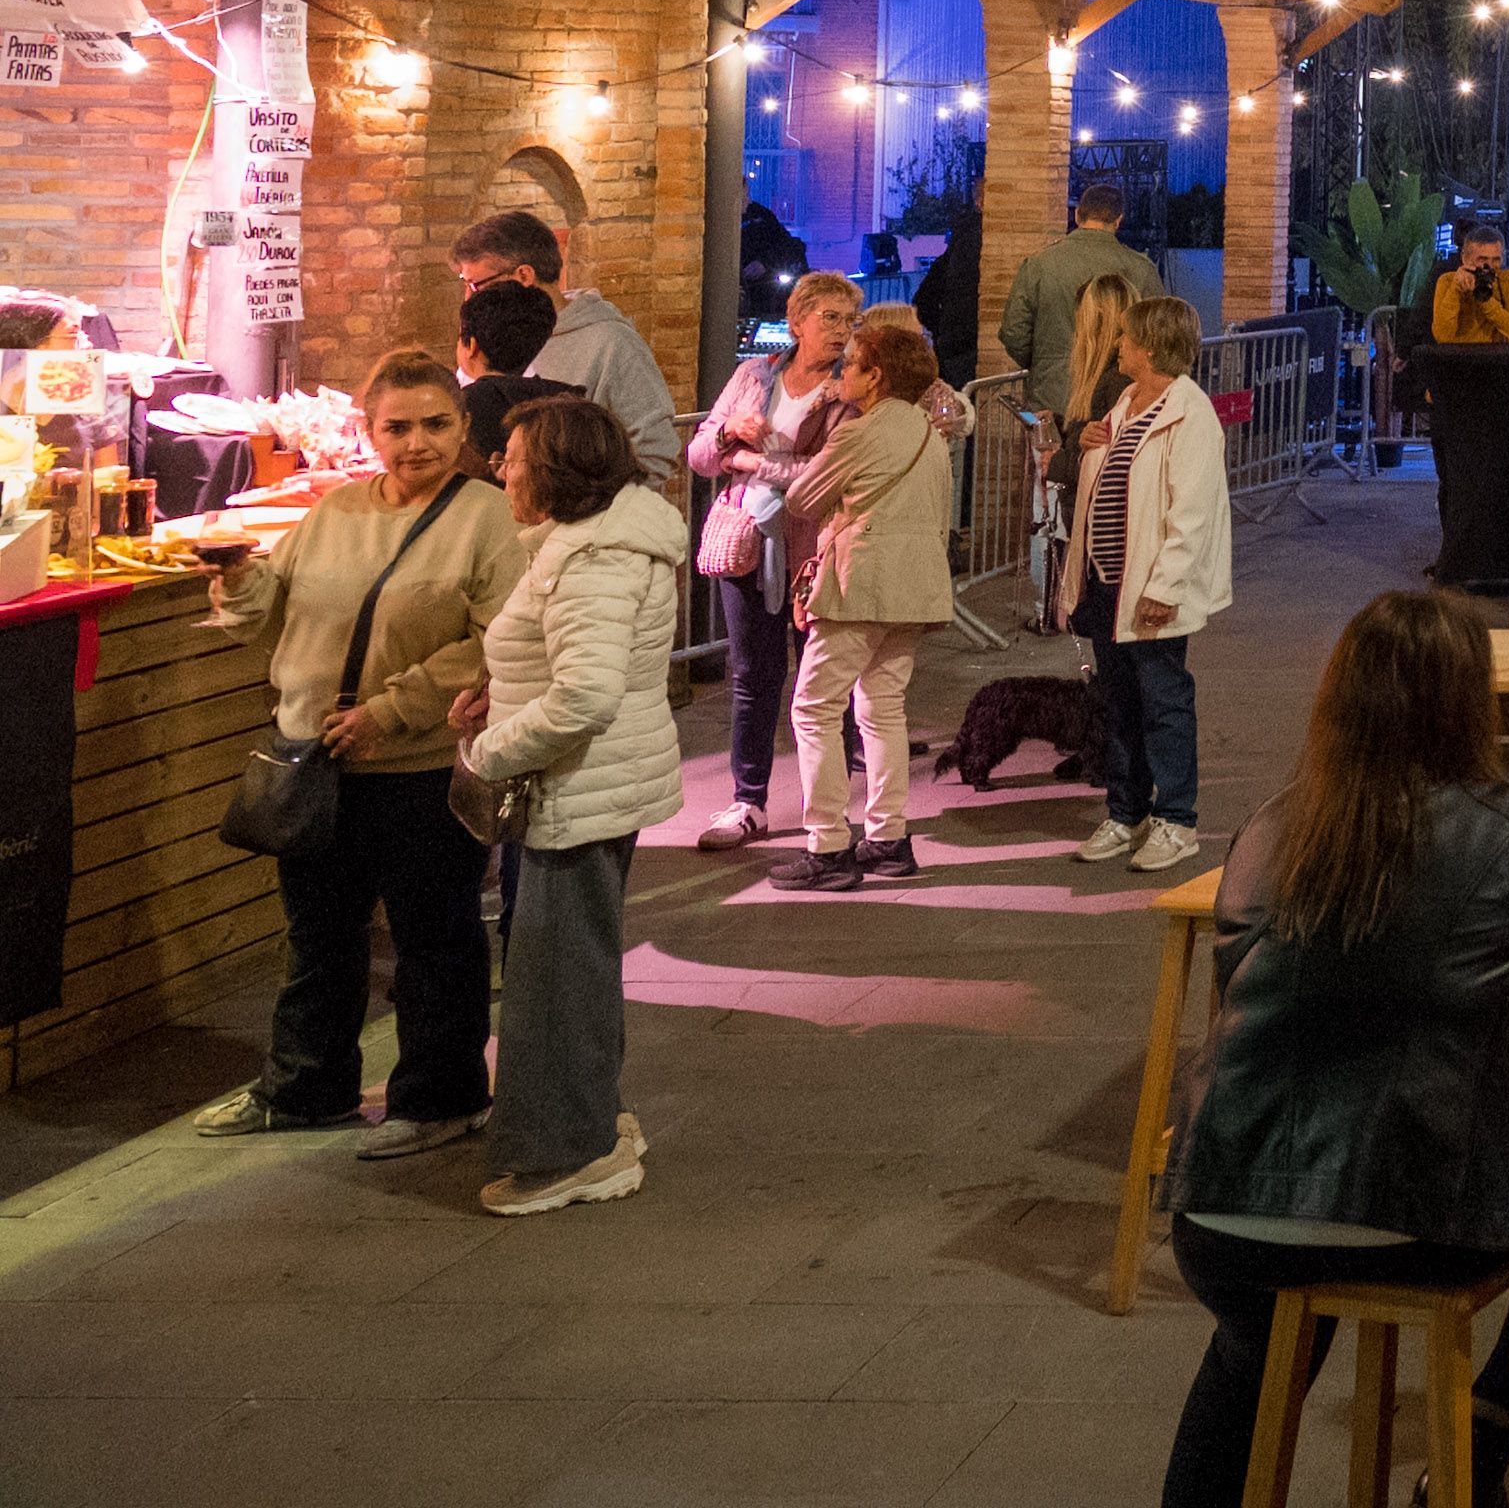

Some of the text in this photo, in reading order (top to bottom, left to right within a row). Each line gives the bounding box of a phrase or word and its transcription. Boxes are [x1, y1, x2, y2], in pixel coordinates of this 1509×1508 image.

[7, 35, 59, 60] PATATAS
[250, 107, 298, 126] VASITO
[259, 241, 298, 261] DUROC
[277, 292, 294, 304] CON
